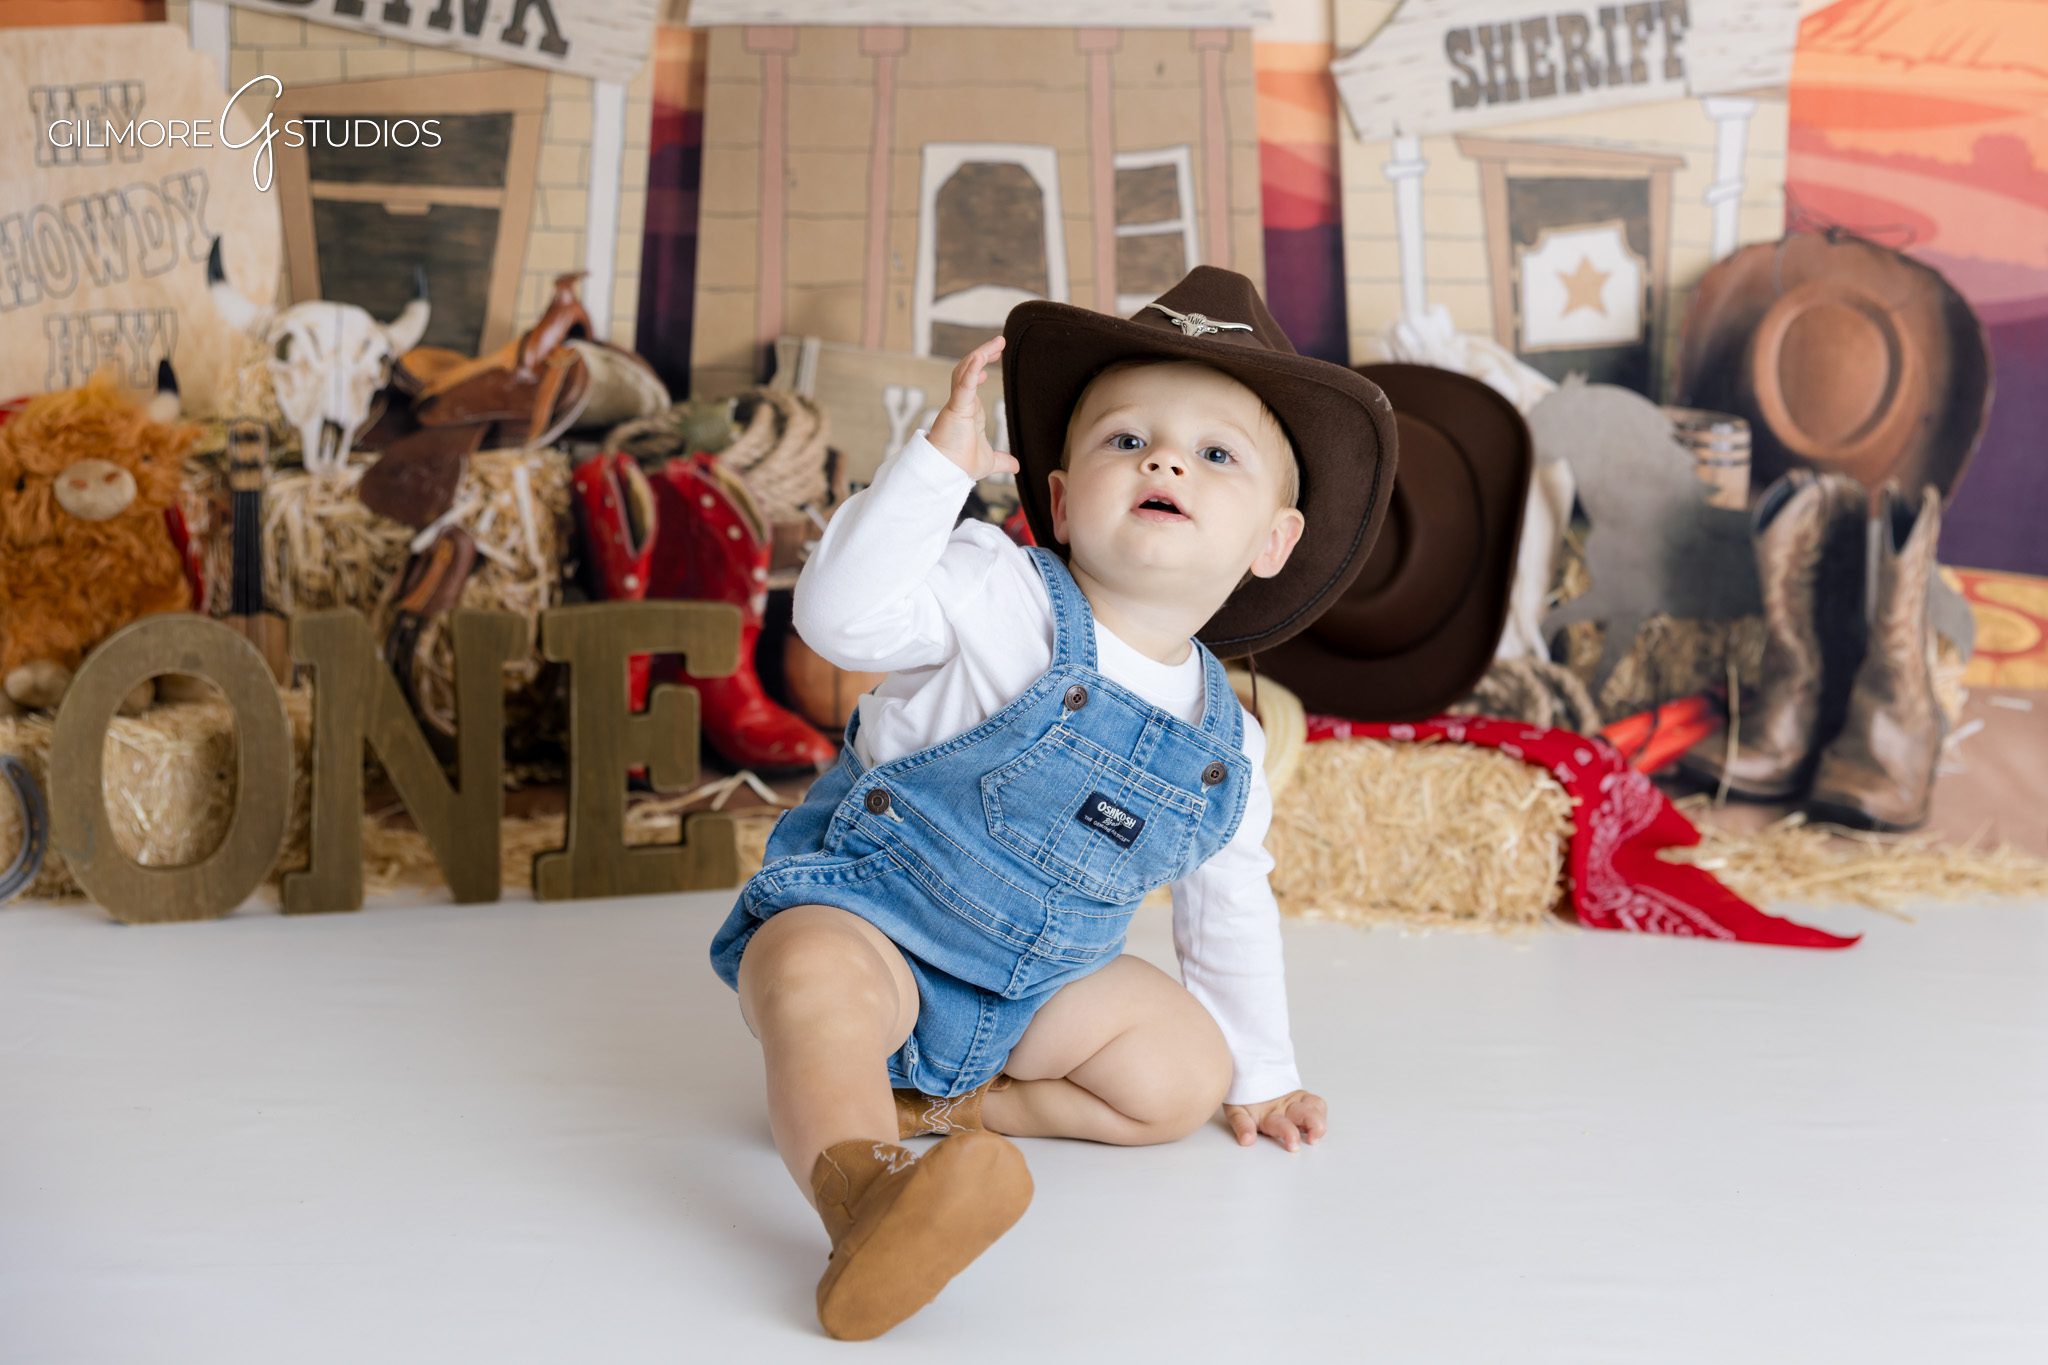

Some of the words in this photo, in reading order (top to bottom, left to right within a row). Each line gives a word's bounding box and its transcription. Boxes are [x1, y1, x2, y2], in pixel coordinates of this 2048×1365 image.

[1445, 0, 1690, 111] SHERIFF
[28, 80, 146, 167] HEY
[0, 168, 210, 313] HOWDY
[49, 600, 743, 924] ONE
